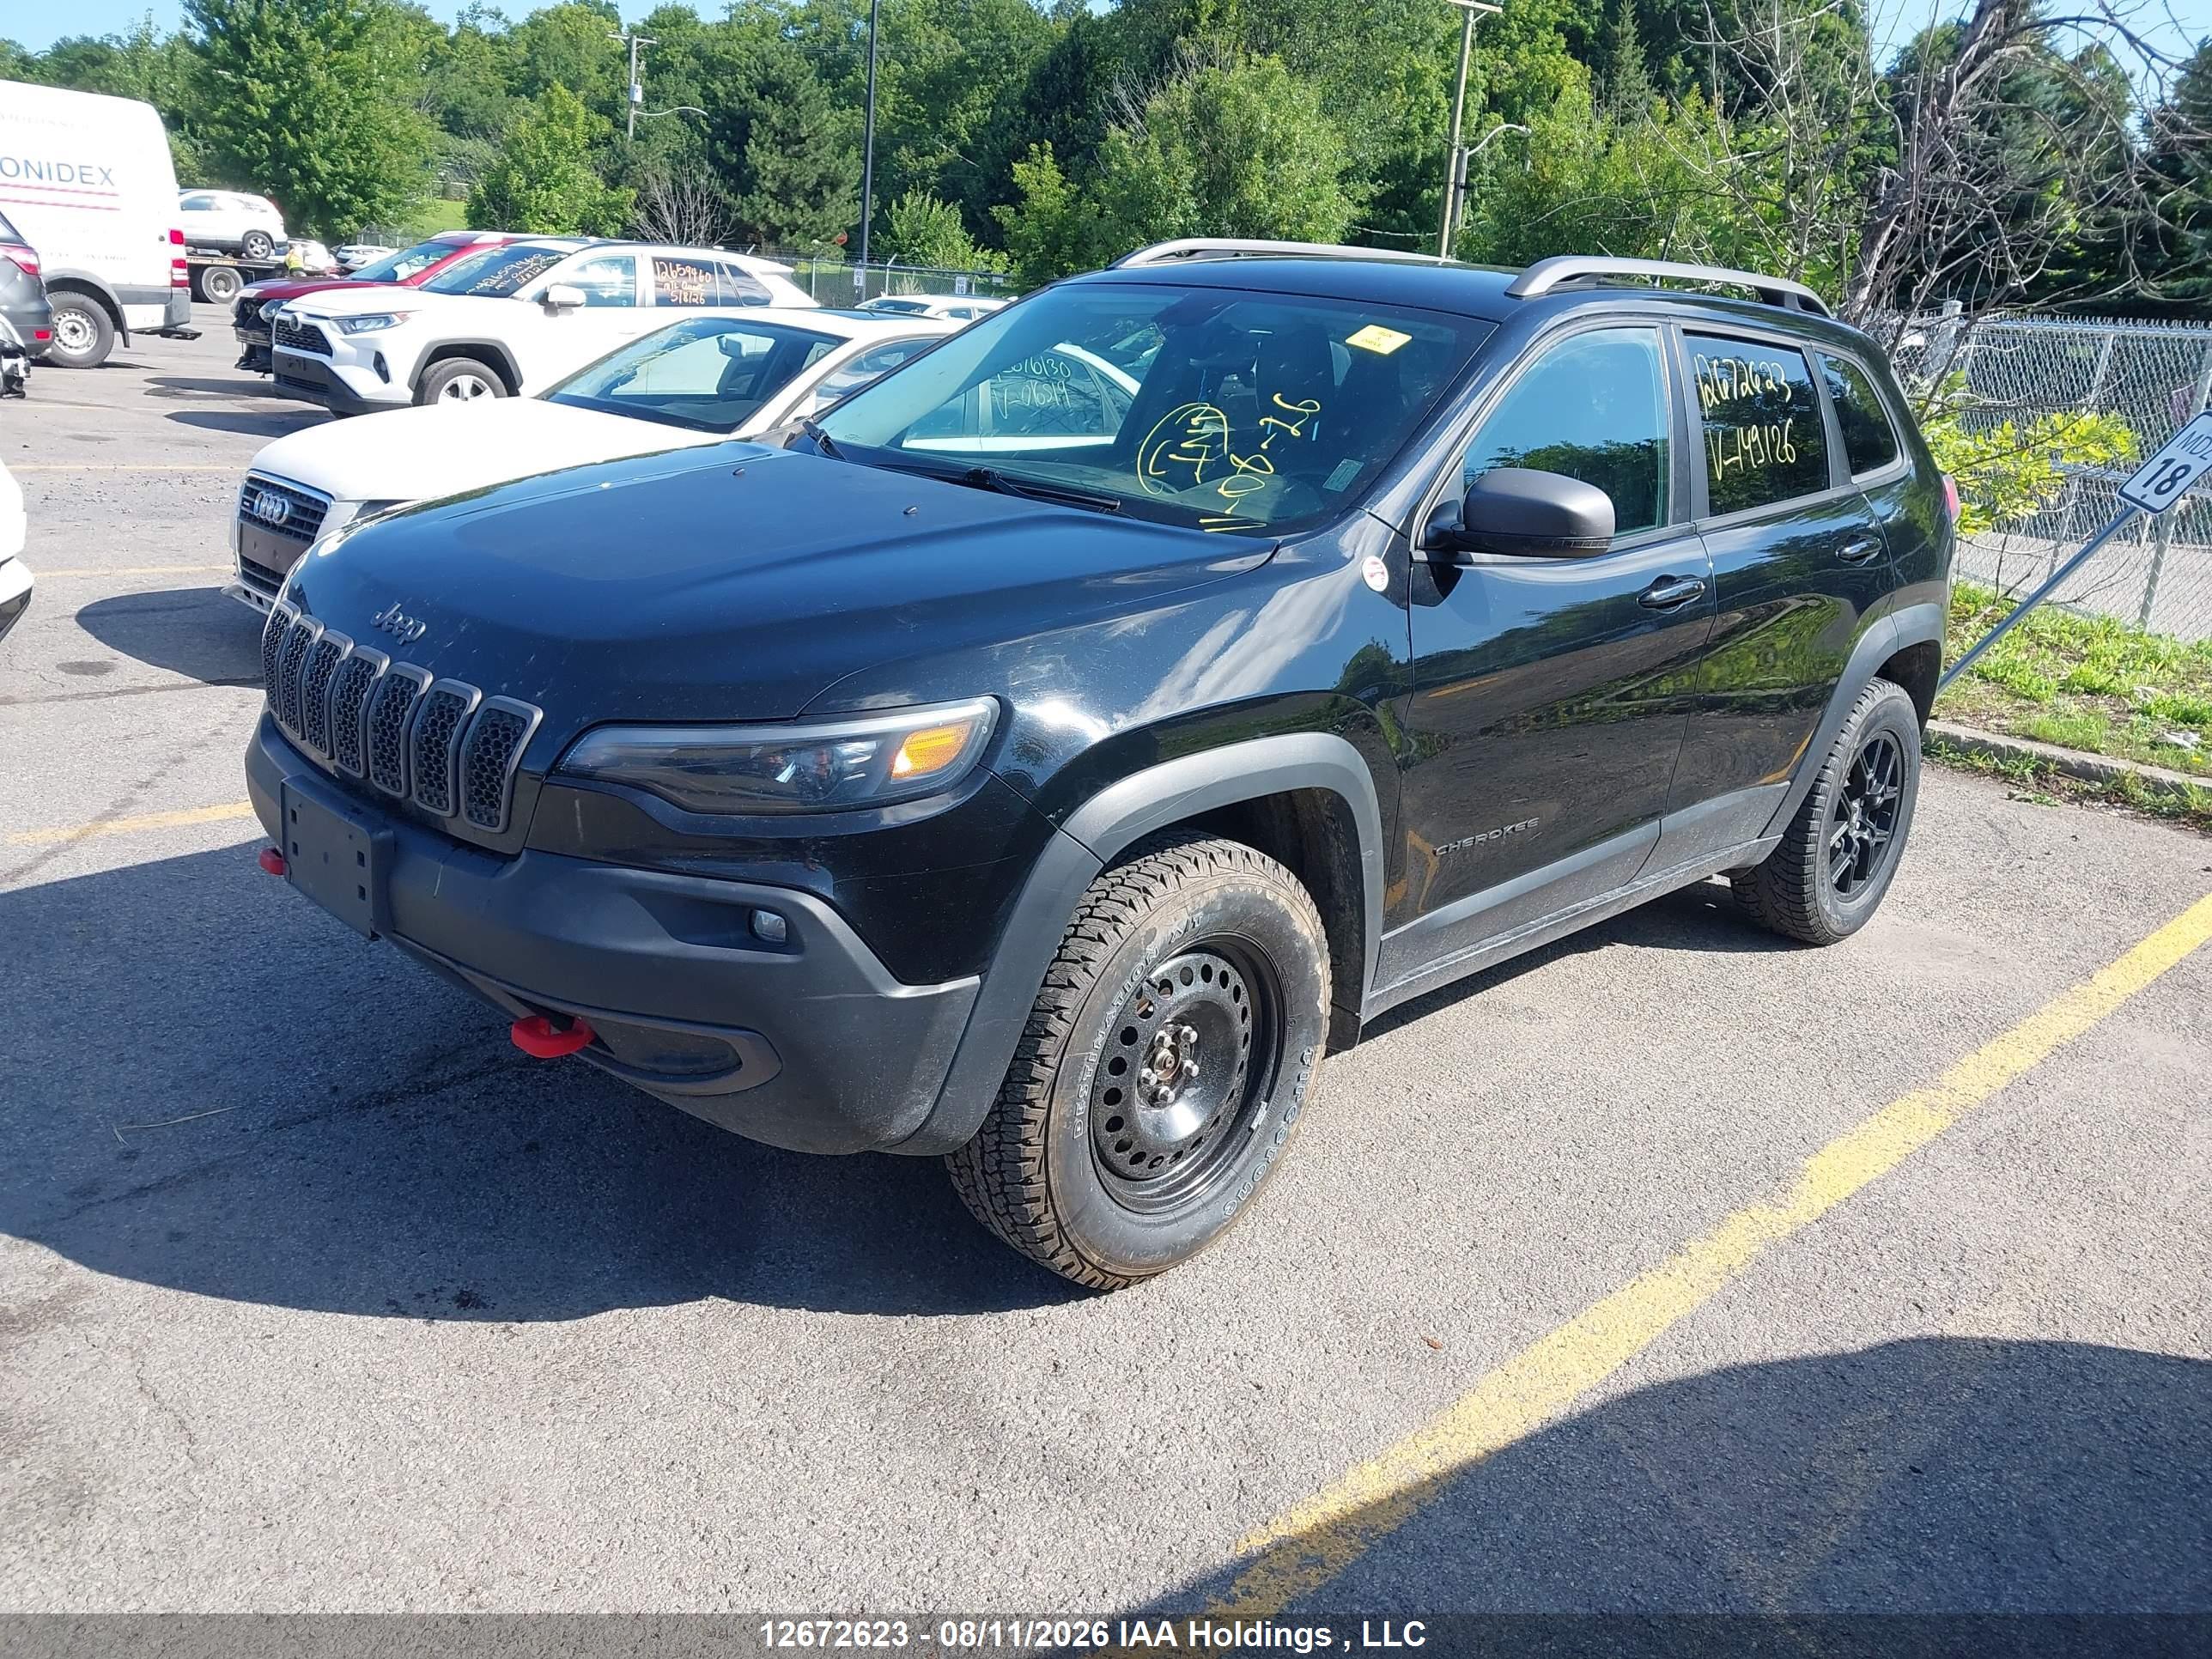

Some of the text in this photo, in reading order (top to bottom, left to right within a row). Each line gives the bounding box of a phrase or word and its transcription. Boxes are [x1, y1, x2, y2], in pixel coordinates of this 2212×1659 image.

[655, 261, 712, 283] 12659460
[957, 285, 964, 294] 10
[1694, 353, 1792, 420] 12672623
[2142, 458, 2192, 495] 18
[370, 601, 427, 646] Jeep
[1435, 817, 1540, 857] CHEROKEE
[1073, 945, 1159, 1140] DESTINATION
